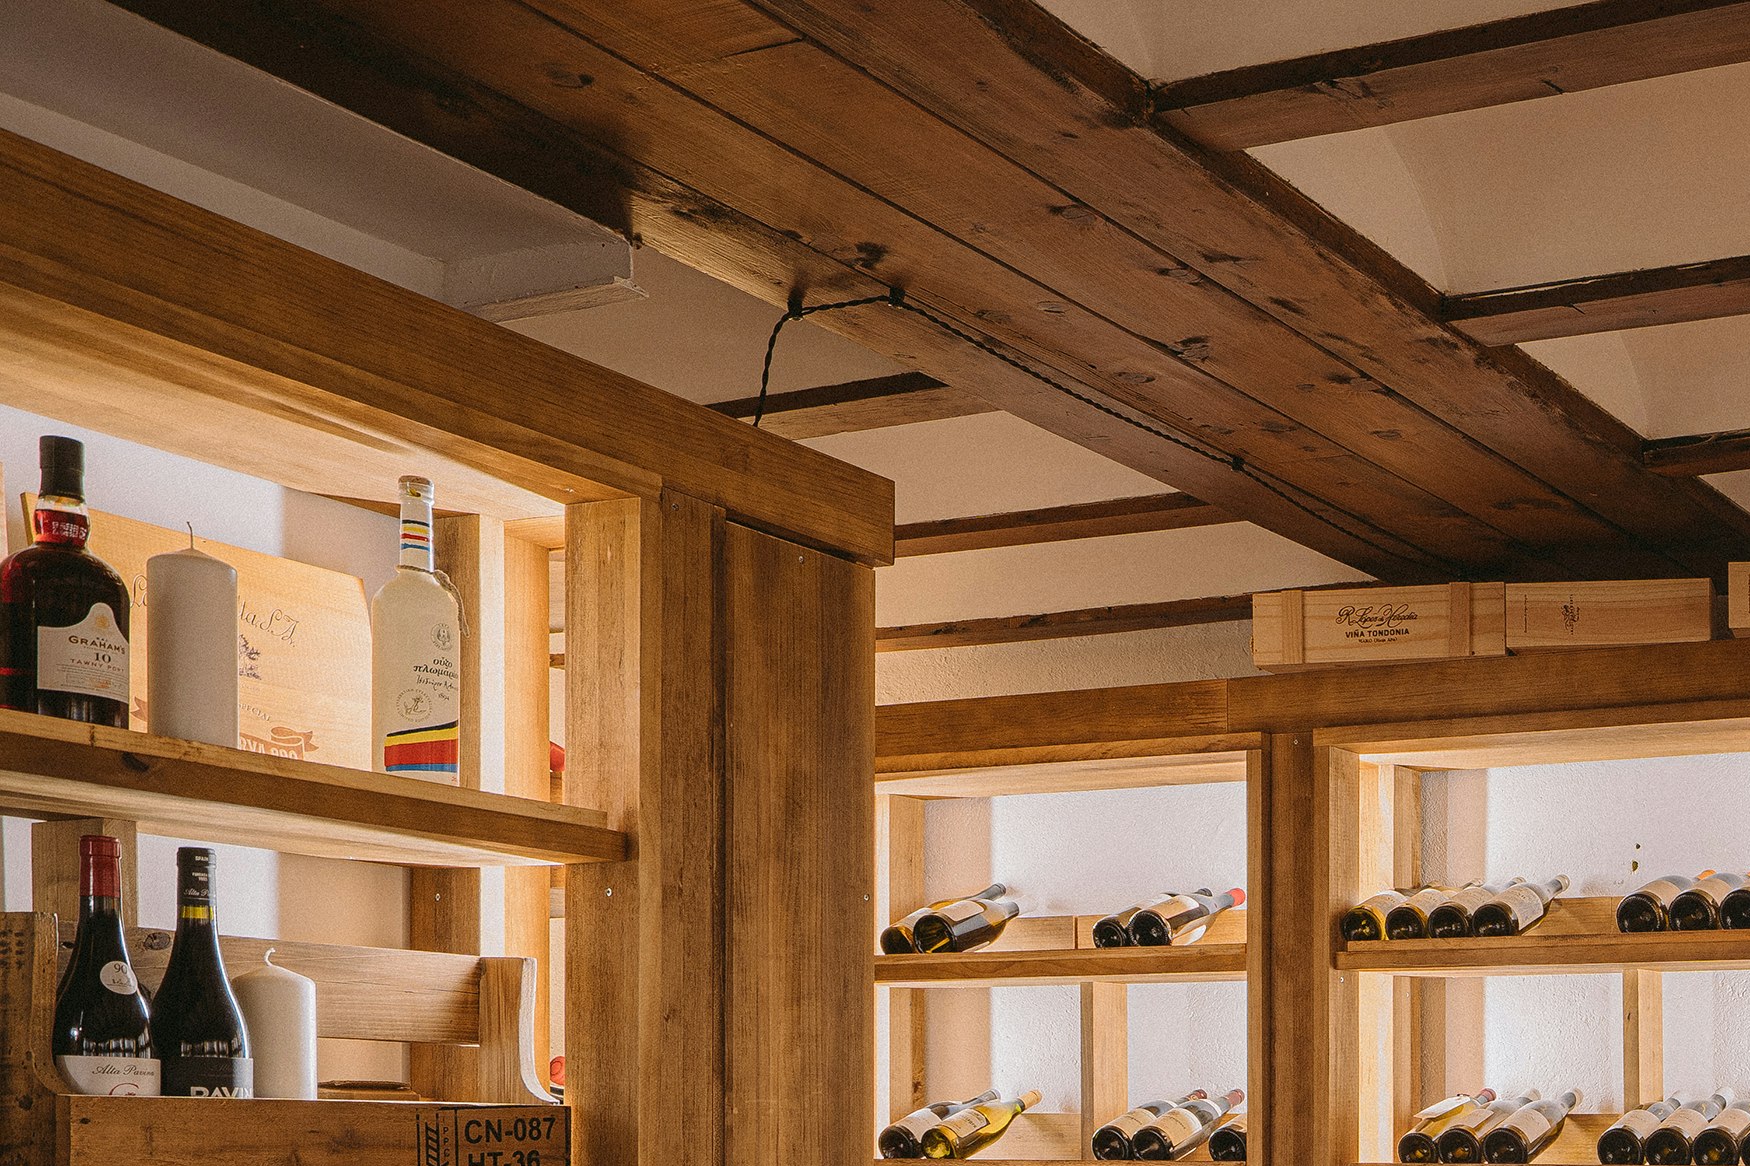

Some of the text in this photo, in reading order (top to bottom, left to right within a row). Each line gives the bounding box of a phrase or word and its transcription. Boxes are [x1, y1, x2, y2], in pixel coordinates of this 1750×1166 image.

[1345, 628, 1410, 639] VIÑA TONDONIA
[68, 634, 126, 655] GRAHAM'S
[69, 658, 104, 669] TAWNY
[94, 652, 112, 664] 10
[91, 1063, 121, 1076] Alta
[190, 1085, 253, 1098] PAVIN
[464, 1116, 557, 1145] CN-087
